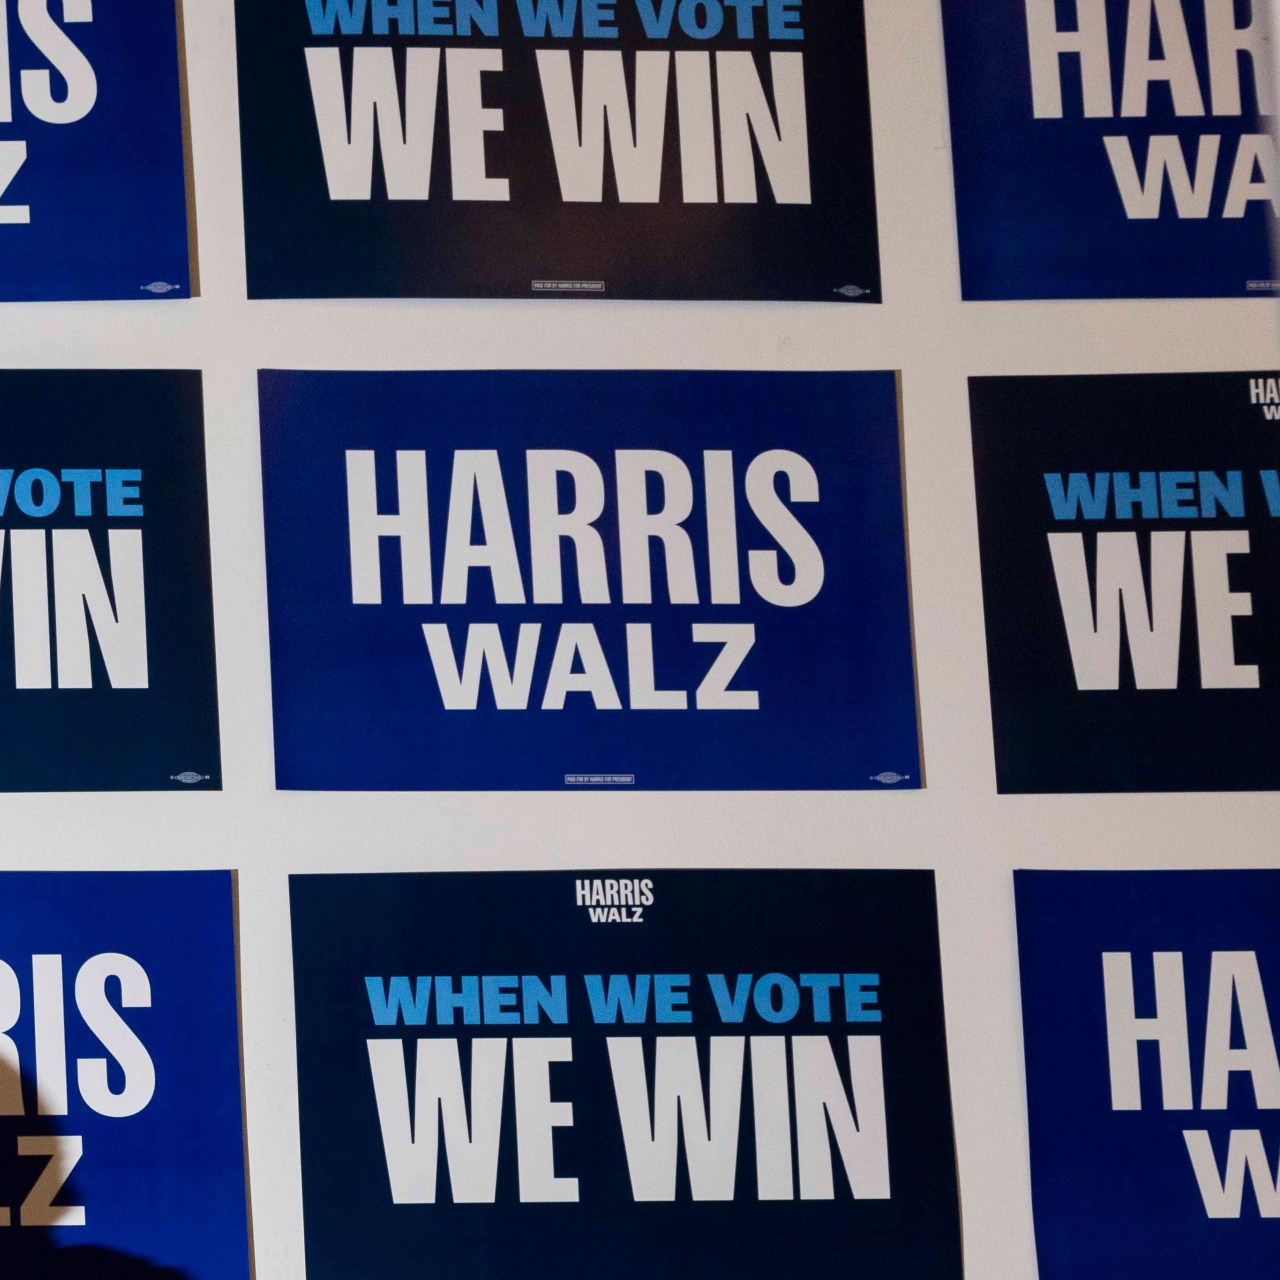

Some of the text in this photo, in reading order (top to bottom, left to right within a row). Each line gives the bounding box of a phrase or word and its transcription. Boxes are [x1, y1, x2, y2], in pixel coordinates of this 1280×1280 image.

[305, 0, 804, 39] WHEN WE VOTE
[305, 47, 811, 204] WE WIN
[1249, 378, 1280, 403] HA
[346, 450, 824, 607] HARRIS
[1044, 471, 1245, 519] WHEN
[1047, 530, 1259, 690] WE
[422, 623, 759, 710] WALZ
[575, 879, 654, 906] HARRIS
[588, 907, 644, 923] WALZ
[365, 973, 881, 1025] WHEN WE VOTE
[1102, 951, 1280, 1110] HA
[367, 1036, 890, 1204] WE WIN
